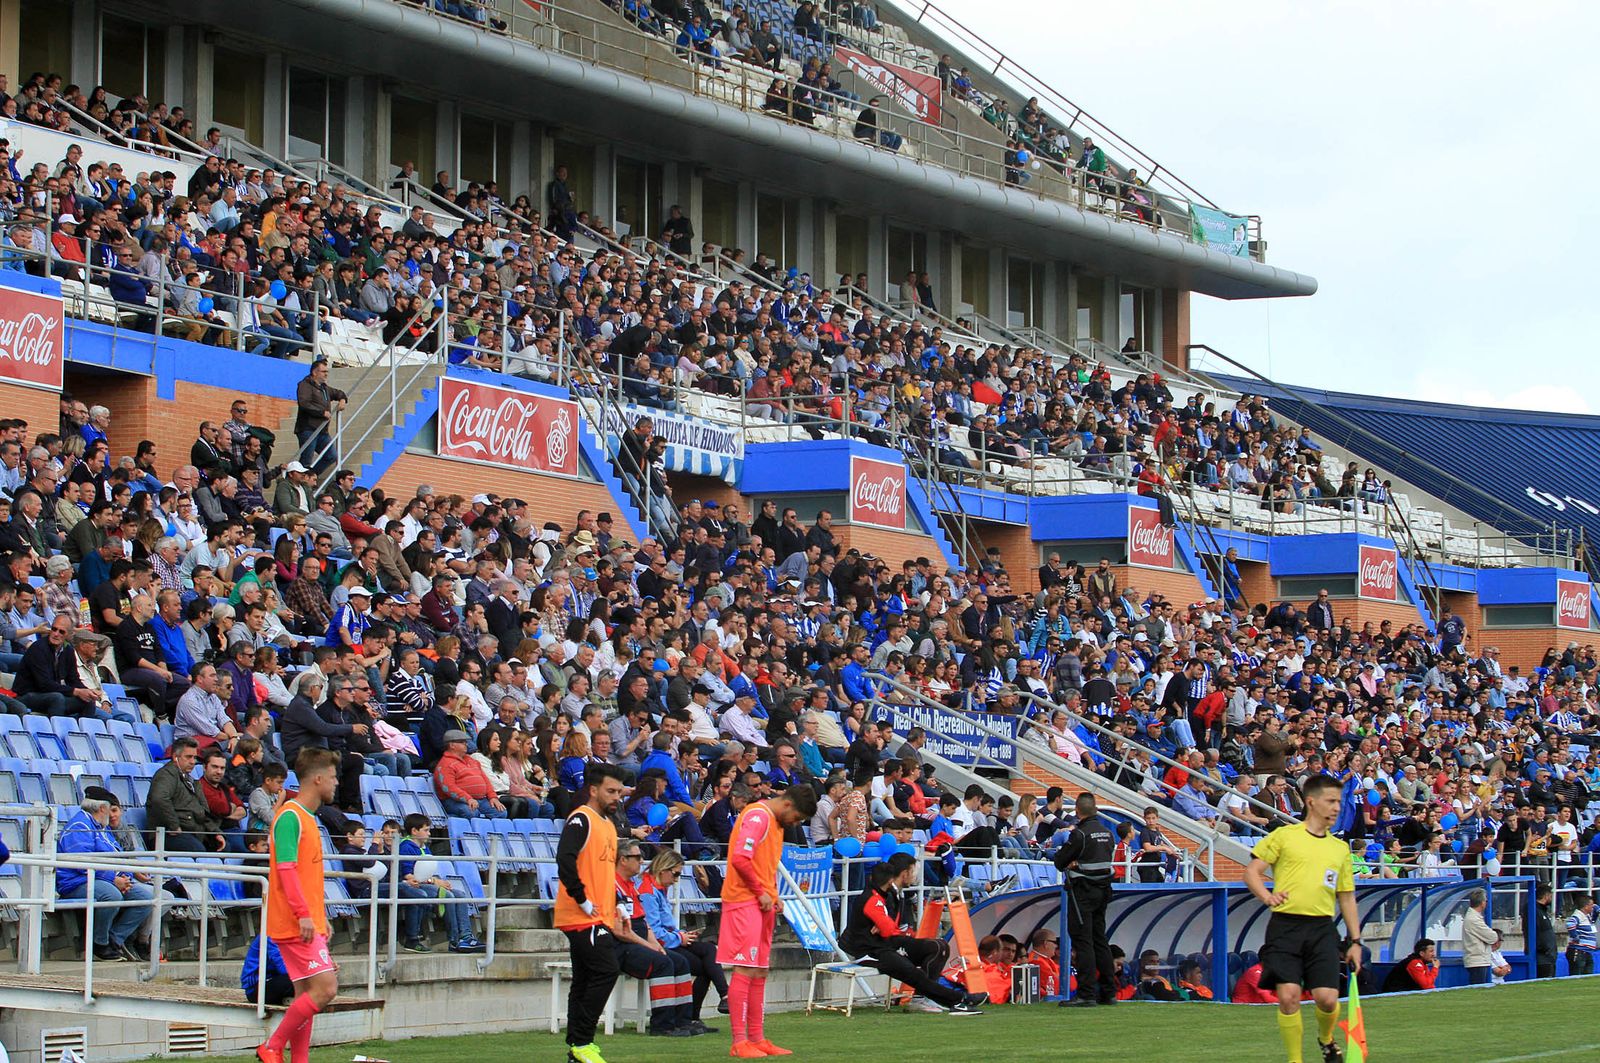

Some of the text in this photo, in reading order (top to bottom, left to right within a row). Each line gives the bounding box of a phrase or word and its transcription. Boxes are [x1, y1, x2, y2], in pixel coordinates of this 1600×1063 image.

[446, 388, 539, 461] Coca-Cola
[689, 424, 699, 447] DE
[700, 426, 737, 455] HINOJOS
[855, 472, 903, 515] Coca-Cola
[1132, 519, 1171, 556] Coca-Cola
[1361, 557, 1395, 590] Coca-Cola
[893, 706, 912, 731] Real
[913, 707, 932, 732] Club
[933, 709, 975, 736] Recreativo
[986, 714, 1012, 739] Huelva
[991, 747, 999, 758] en
[999, 744, 1012, 760] 1889
